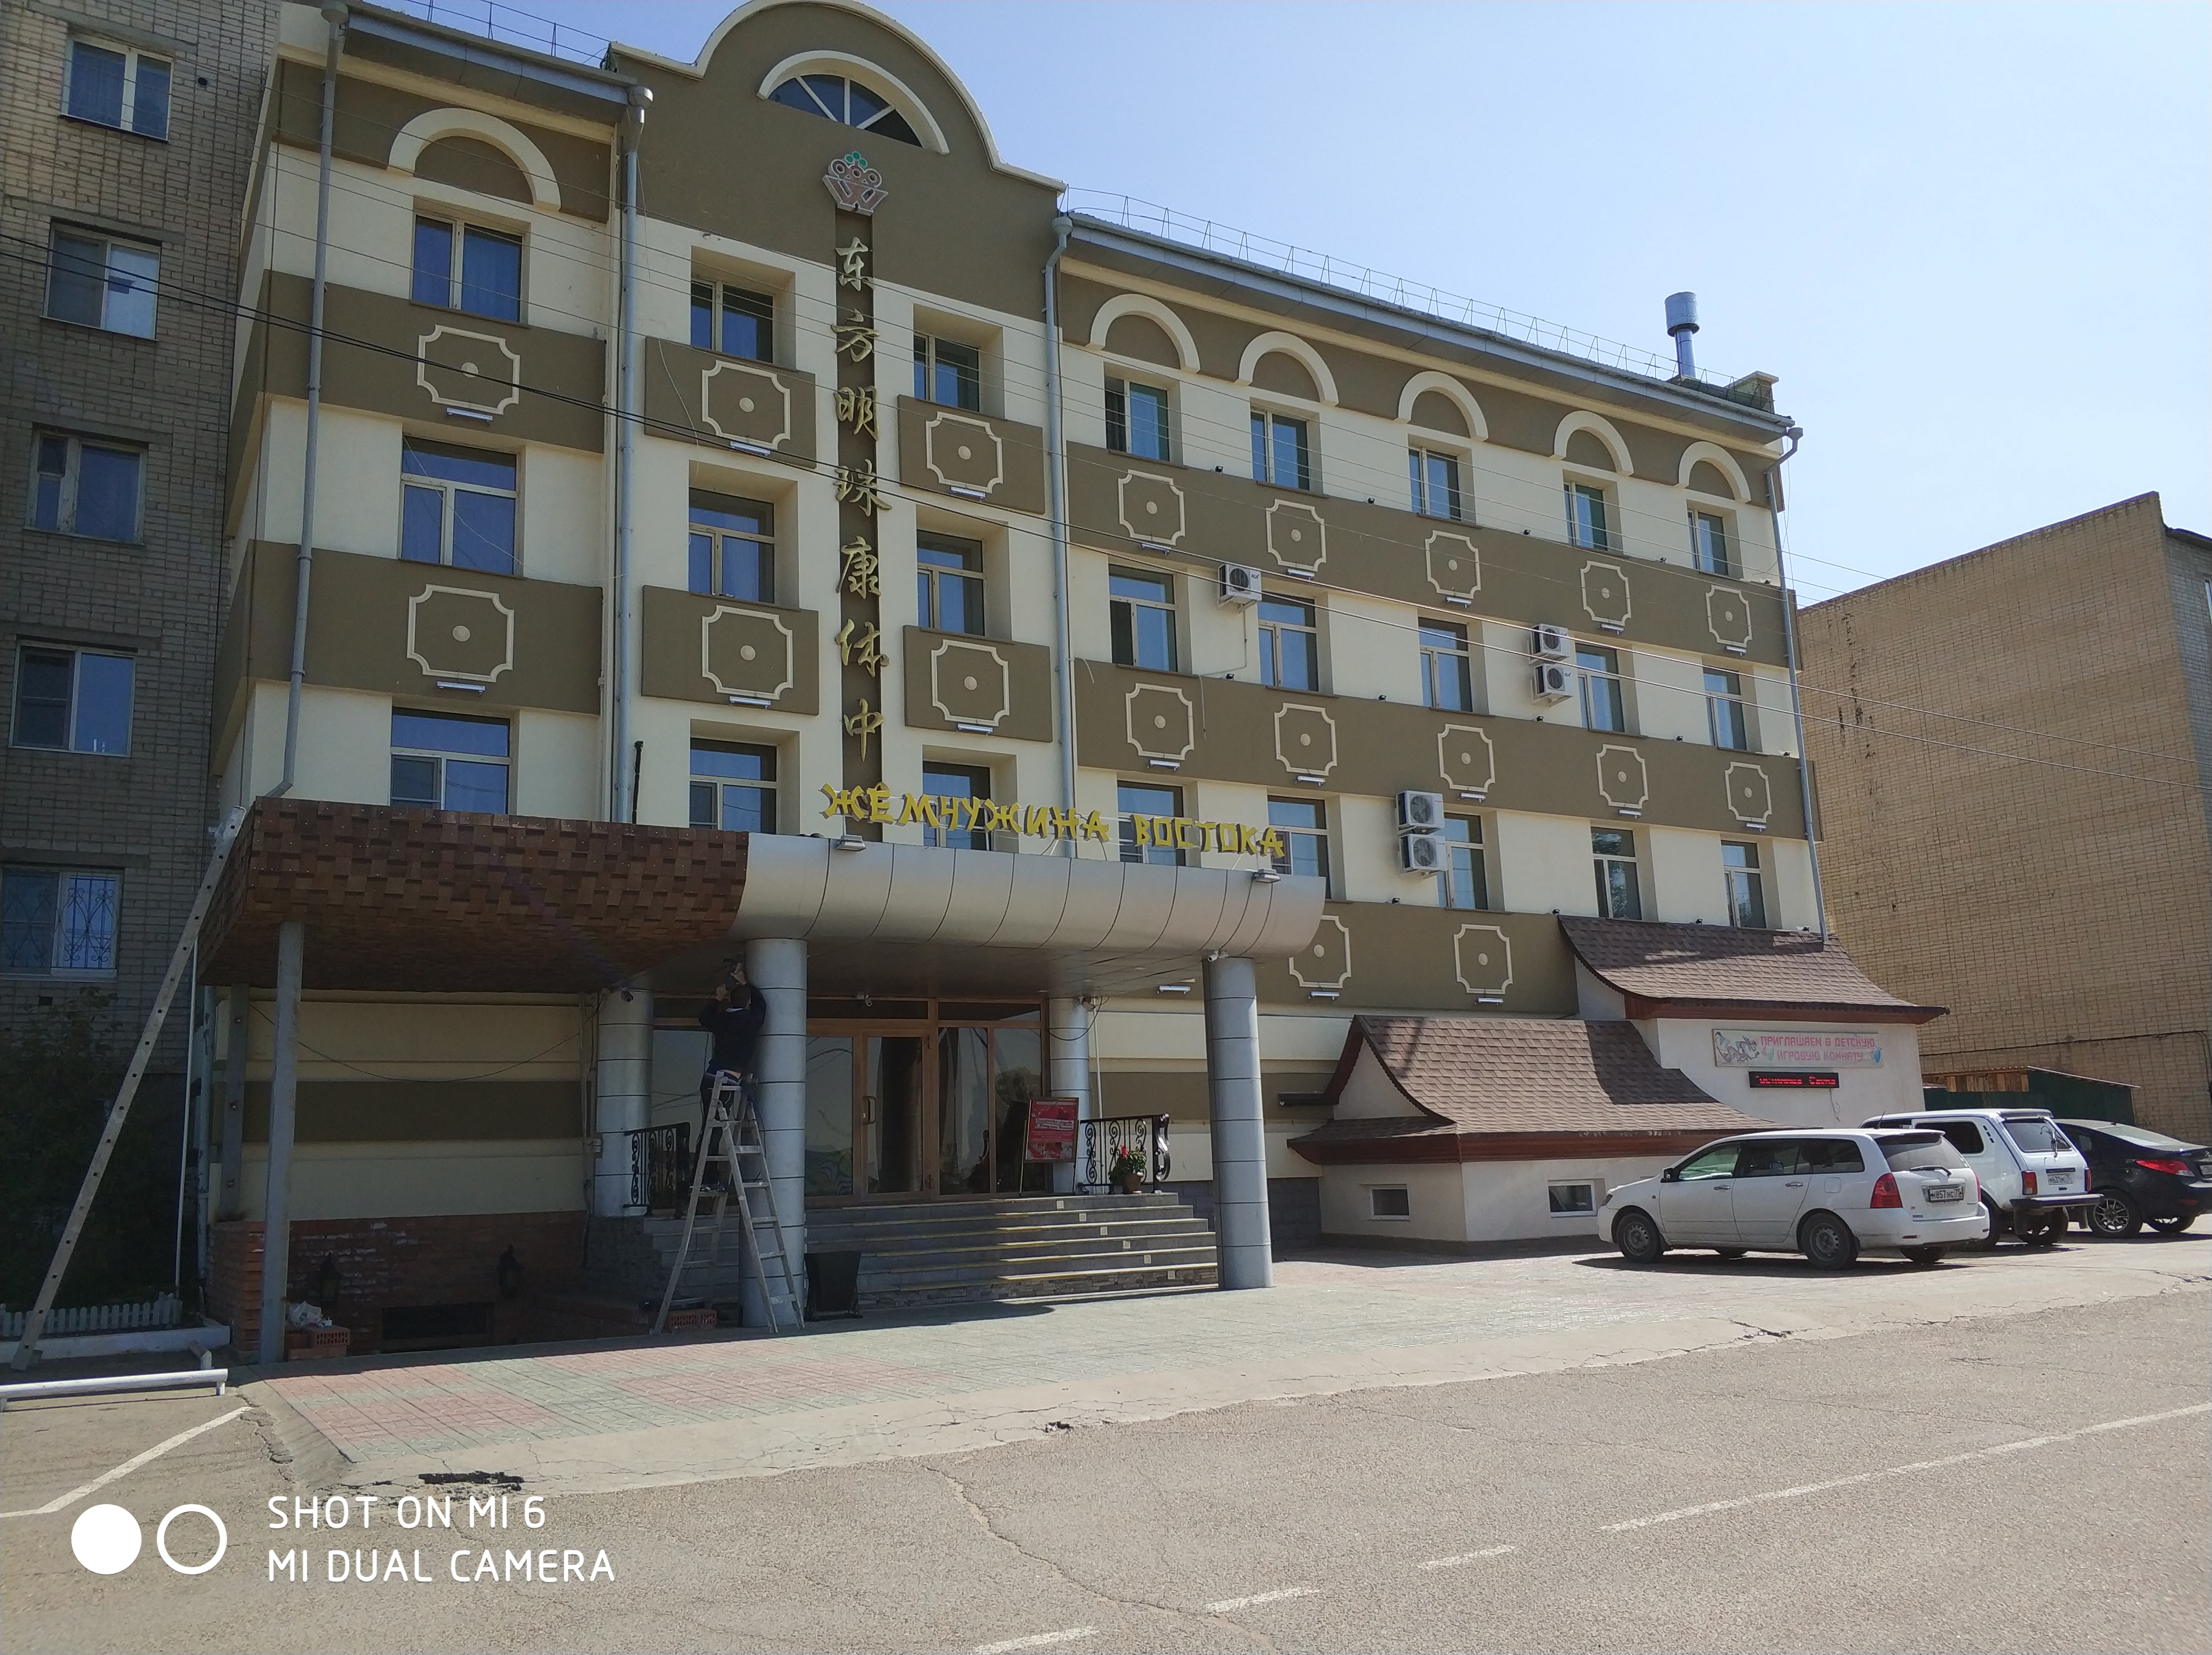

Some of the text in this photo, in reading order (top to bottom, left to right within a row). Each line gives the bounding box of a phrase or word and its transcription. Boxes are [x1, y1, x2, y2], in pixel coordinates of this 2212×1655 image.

[819, 783, 1285, 858] ЖЕМЧУЖИНА ВОСТОКА
[1760, 1036, 1875, 1048] ПРИГЛАШАЕМ В ДЕТСКУЮ
[1777, 1050, 1864, 1062] ИГРОВУЮ КОМНАТУ
